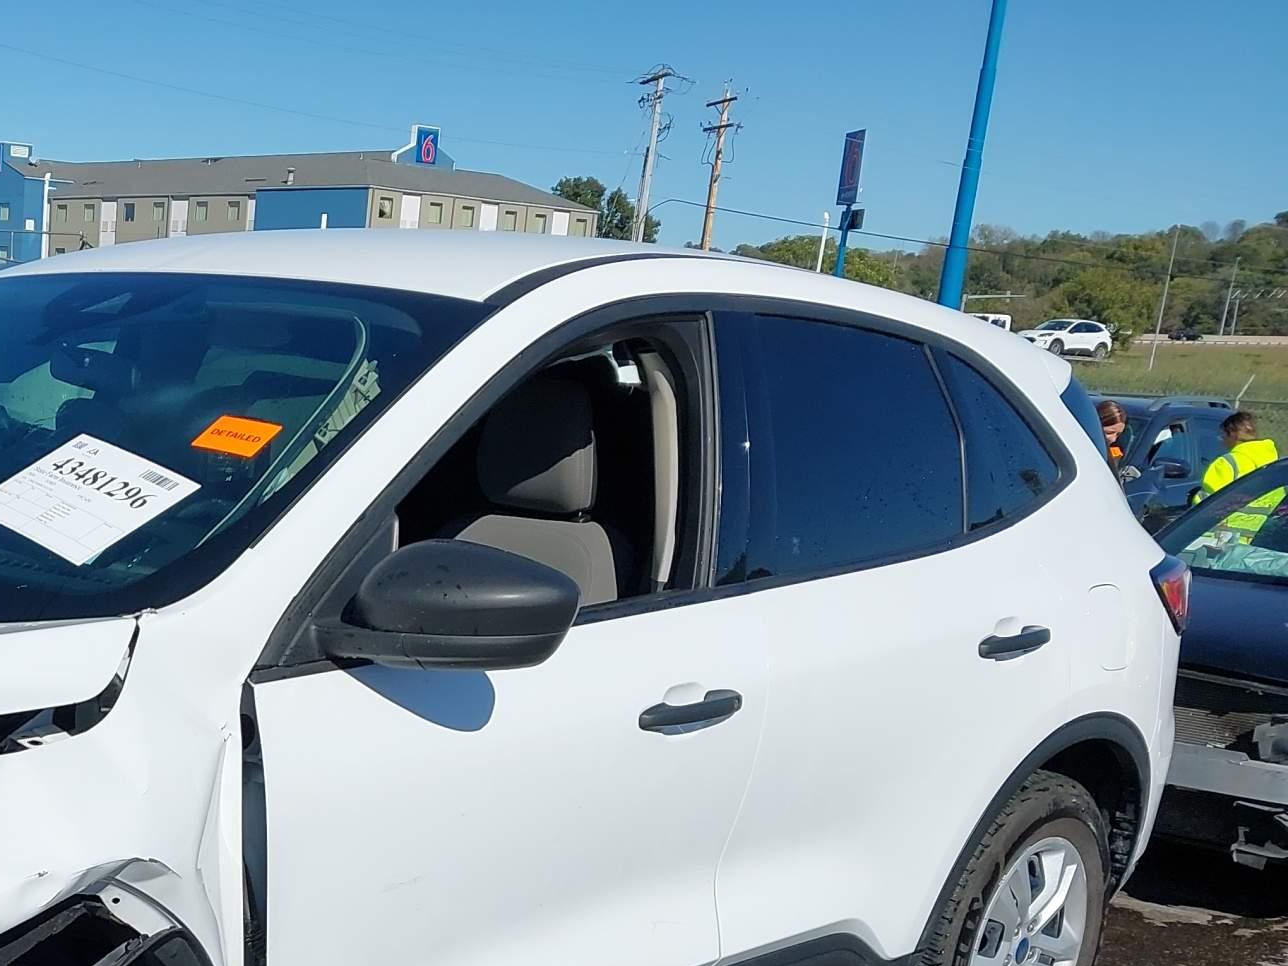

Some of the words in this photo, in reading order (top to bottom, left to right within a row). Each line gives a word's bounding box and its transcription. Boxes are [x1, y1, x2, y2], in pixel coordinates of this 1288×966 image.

[421, 133, 435, 163] 6
[210, 428, 261, 443] DETAILED
[52, 458, 158, 509] 43481296
